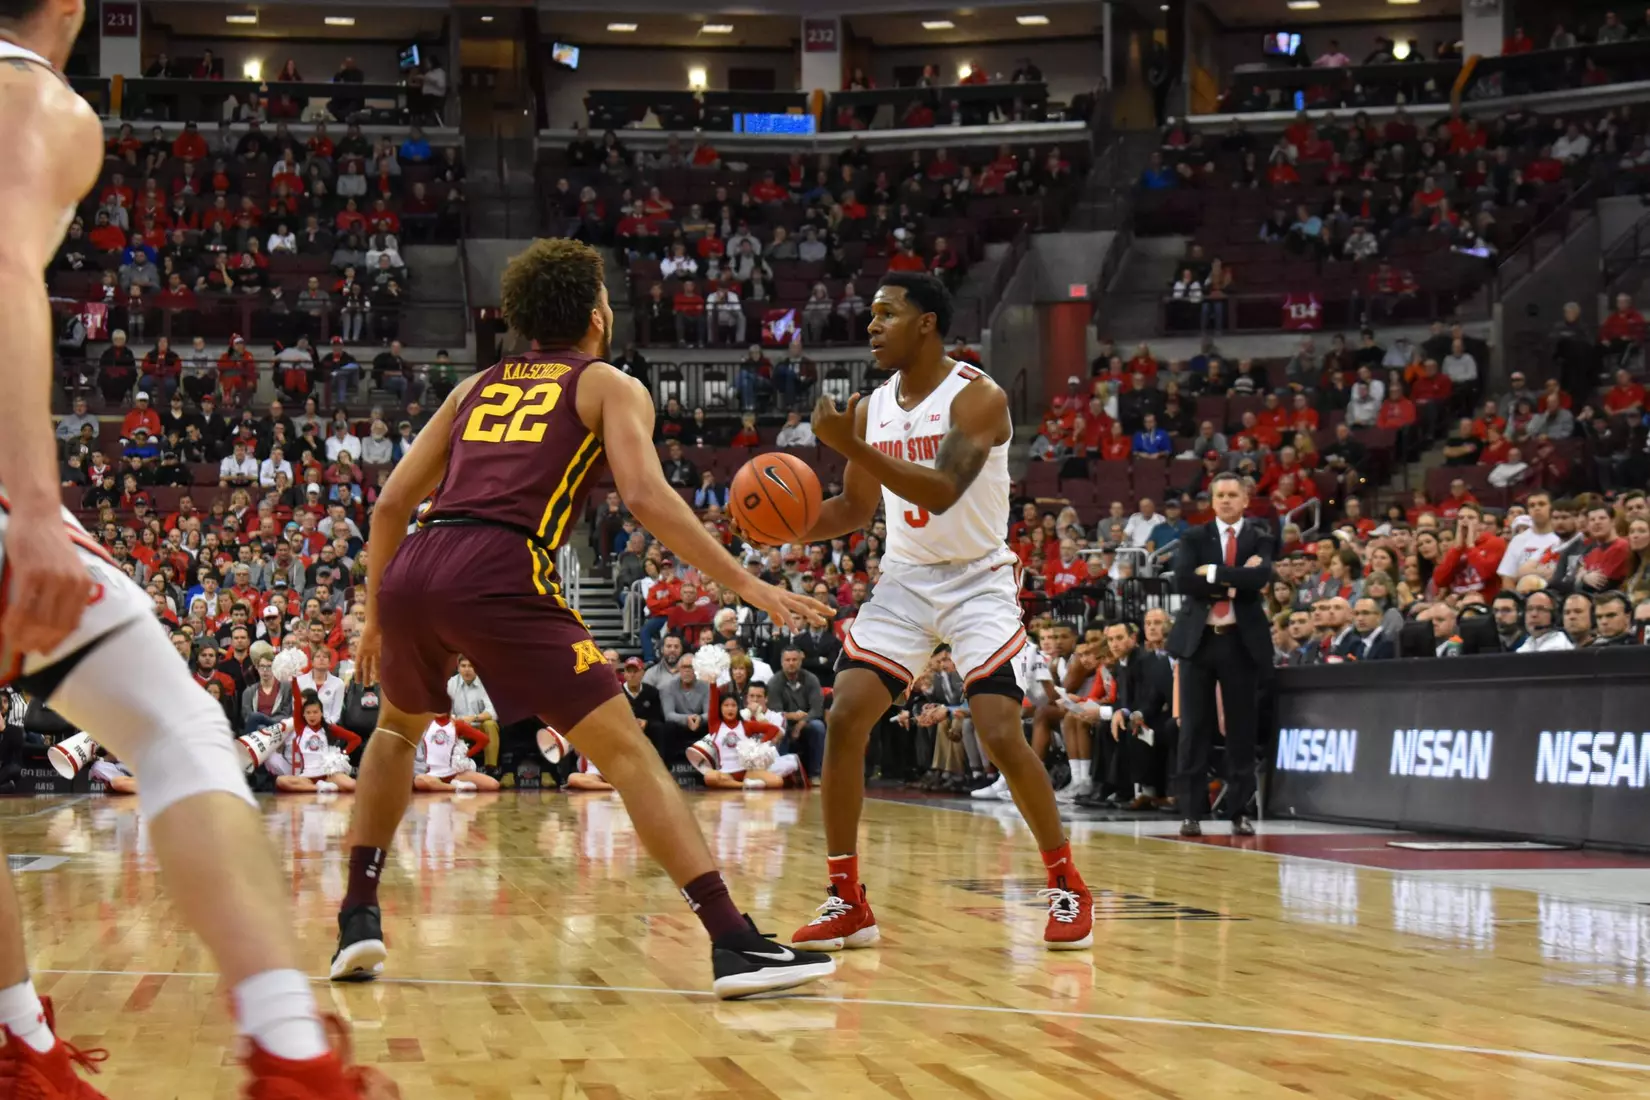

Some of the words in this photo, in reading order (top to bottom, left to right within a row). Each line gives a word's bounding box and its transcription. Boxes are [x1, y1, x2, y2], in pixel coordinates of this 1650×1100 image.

[107, 12, 133, 26] 231
[1290, 303, 1318, 319] 134
[461, 382, 563, 443] 22
[907, 433, 946, 462] STAT
[1276, 728, 1357, 773] NISSAN
[1389, 729, 1493, 780] NISSAN
